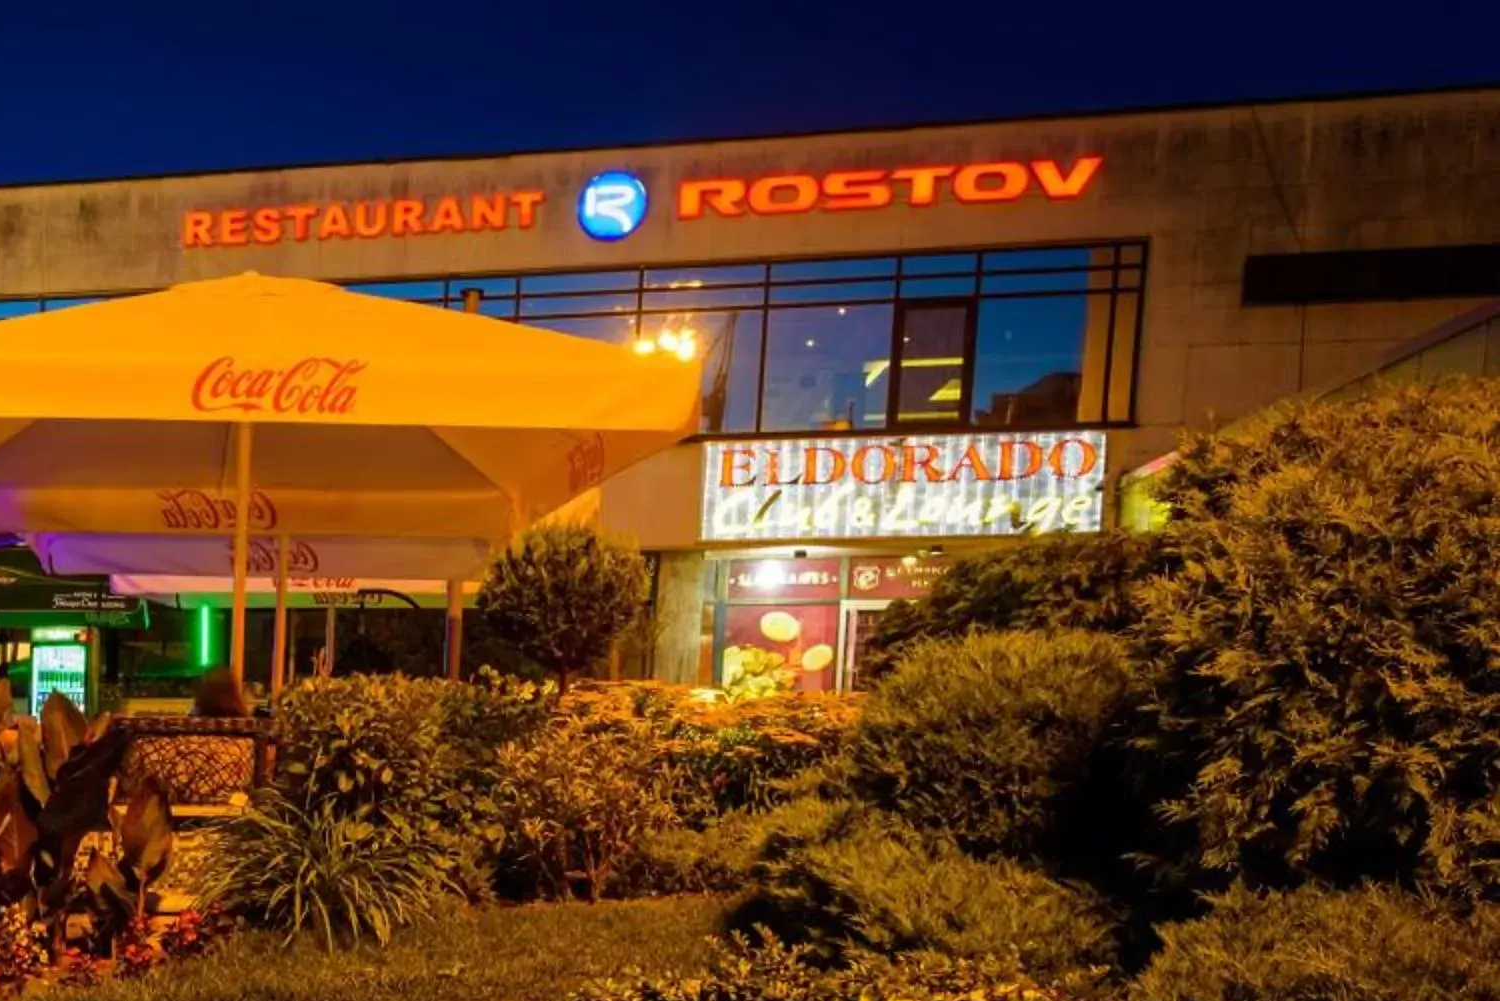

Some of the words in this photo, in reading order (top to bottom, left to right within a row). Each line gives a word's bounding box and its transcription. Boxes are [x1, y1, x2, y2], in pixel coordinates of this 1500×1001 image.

[181, 189, 545, 249] RESTAURANT
[676, 156, 1103, 222] ROSTOV
[191, 355, 367, 415] Coca-Cola
[719, 438, 1099, 488] ELDORADO
